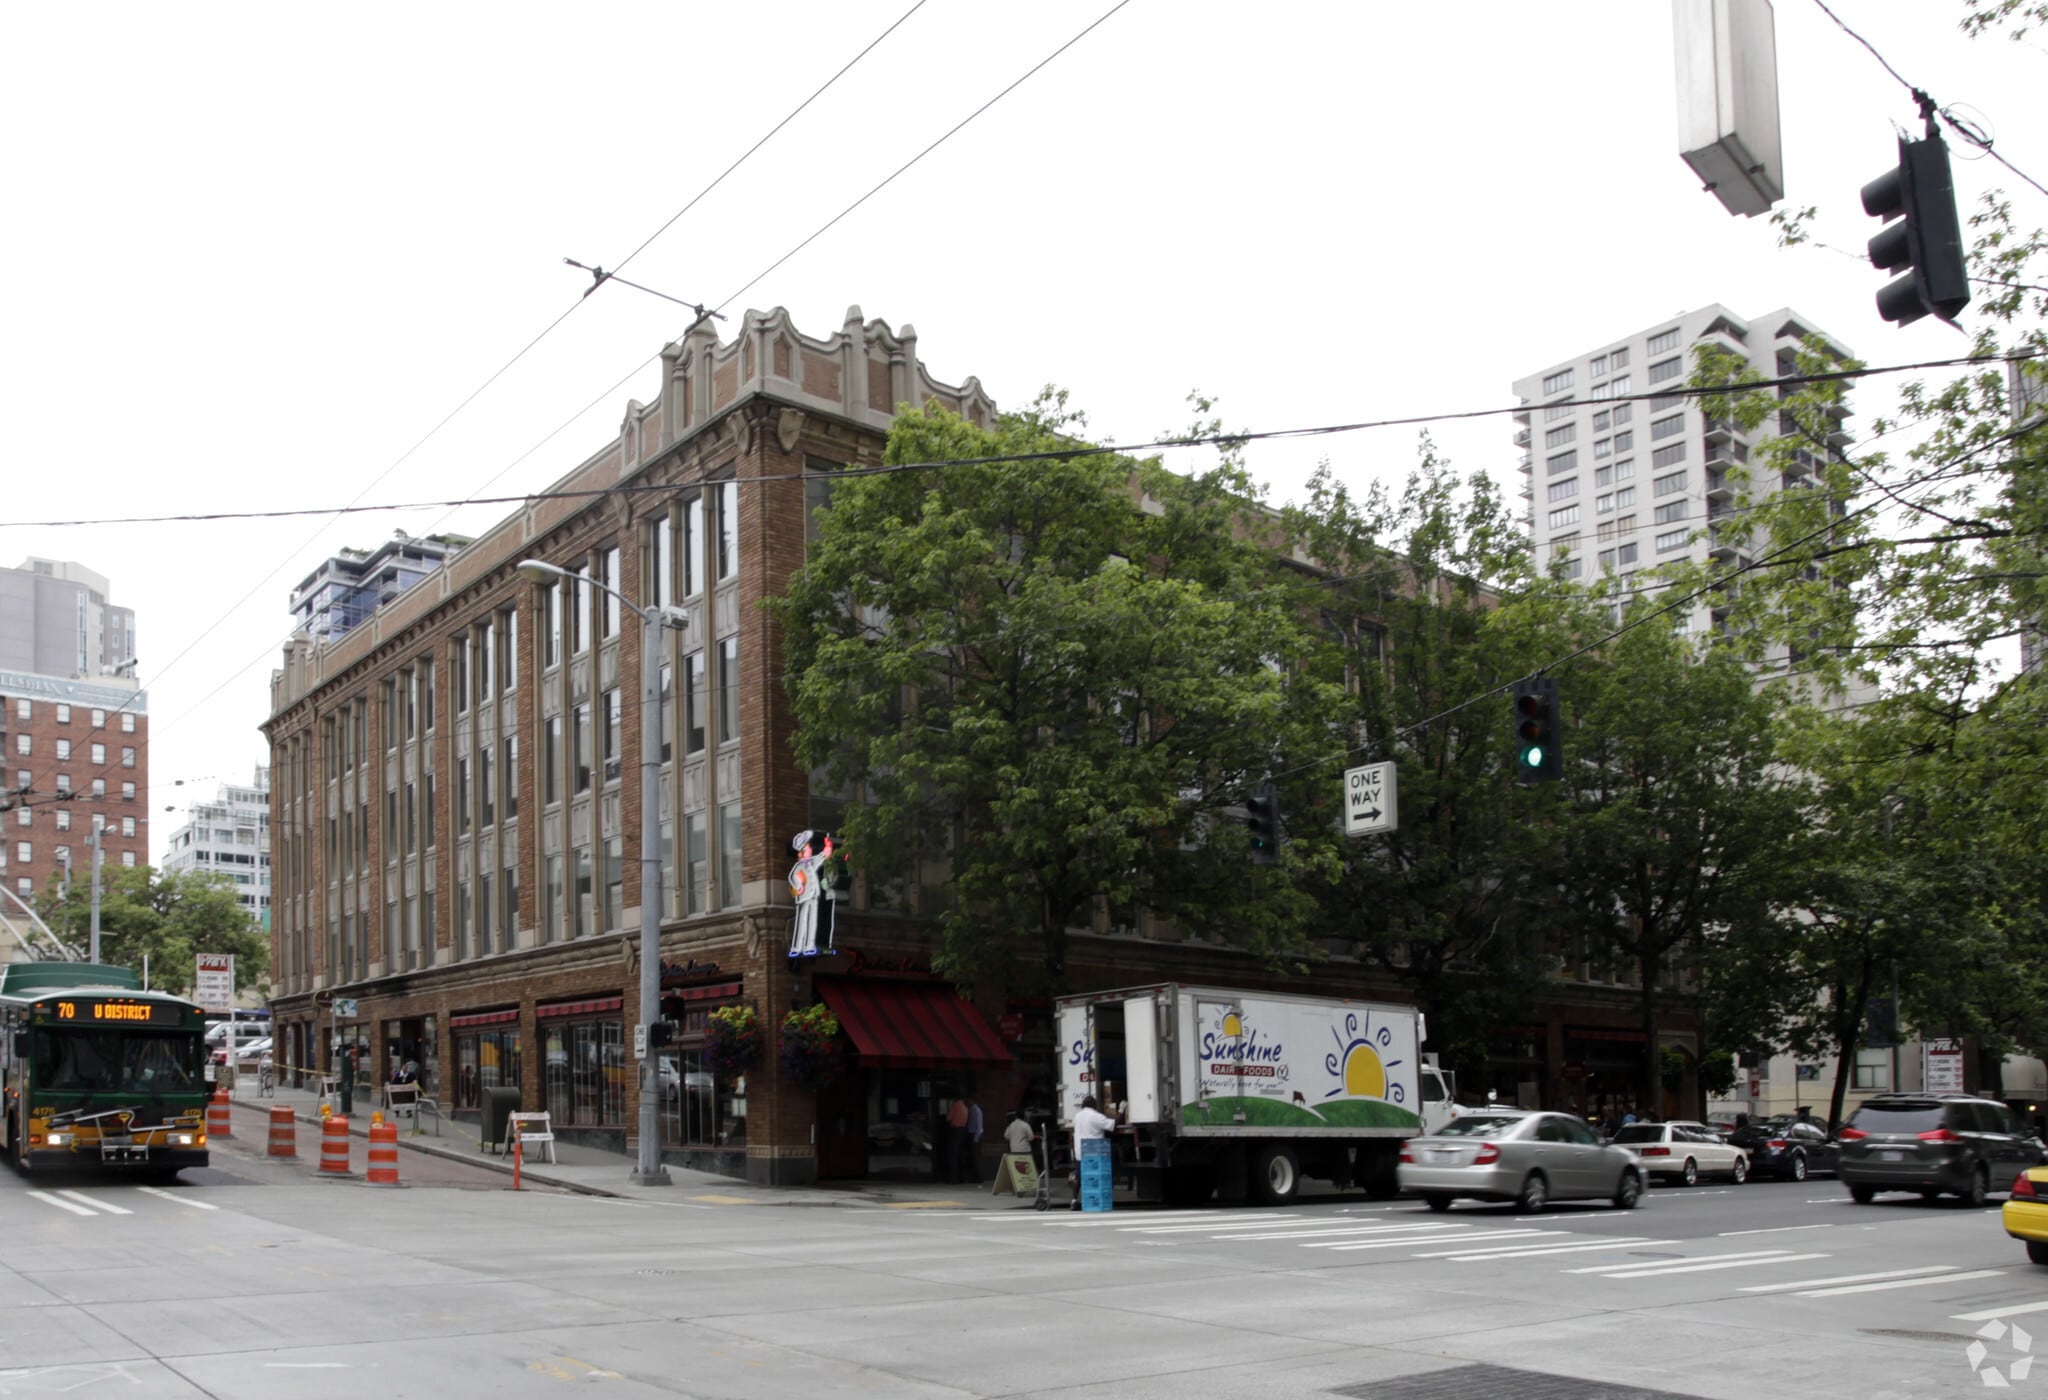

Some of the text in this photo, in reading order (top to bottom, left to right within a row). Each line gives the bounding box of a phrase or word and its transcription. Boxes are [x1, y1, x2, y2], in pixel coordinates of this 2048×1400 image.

[1351, 771, 1380, 788] ONE
[1351, 788, 1381, 806] WAY
[58, 1003, 151, 1020] 70 U DISTRICT
[1200, 1028, 1282, 1062] Sunshine
[1213, 1065, 1273, 1076] DAIR FOODS
